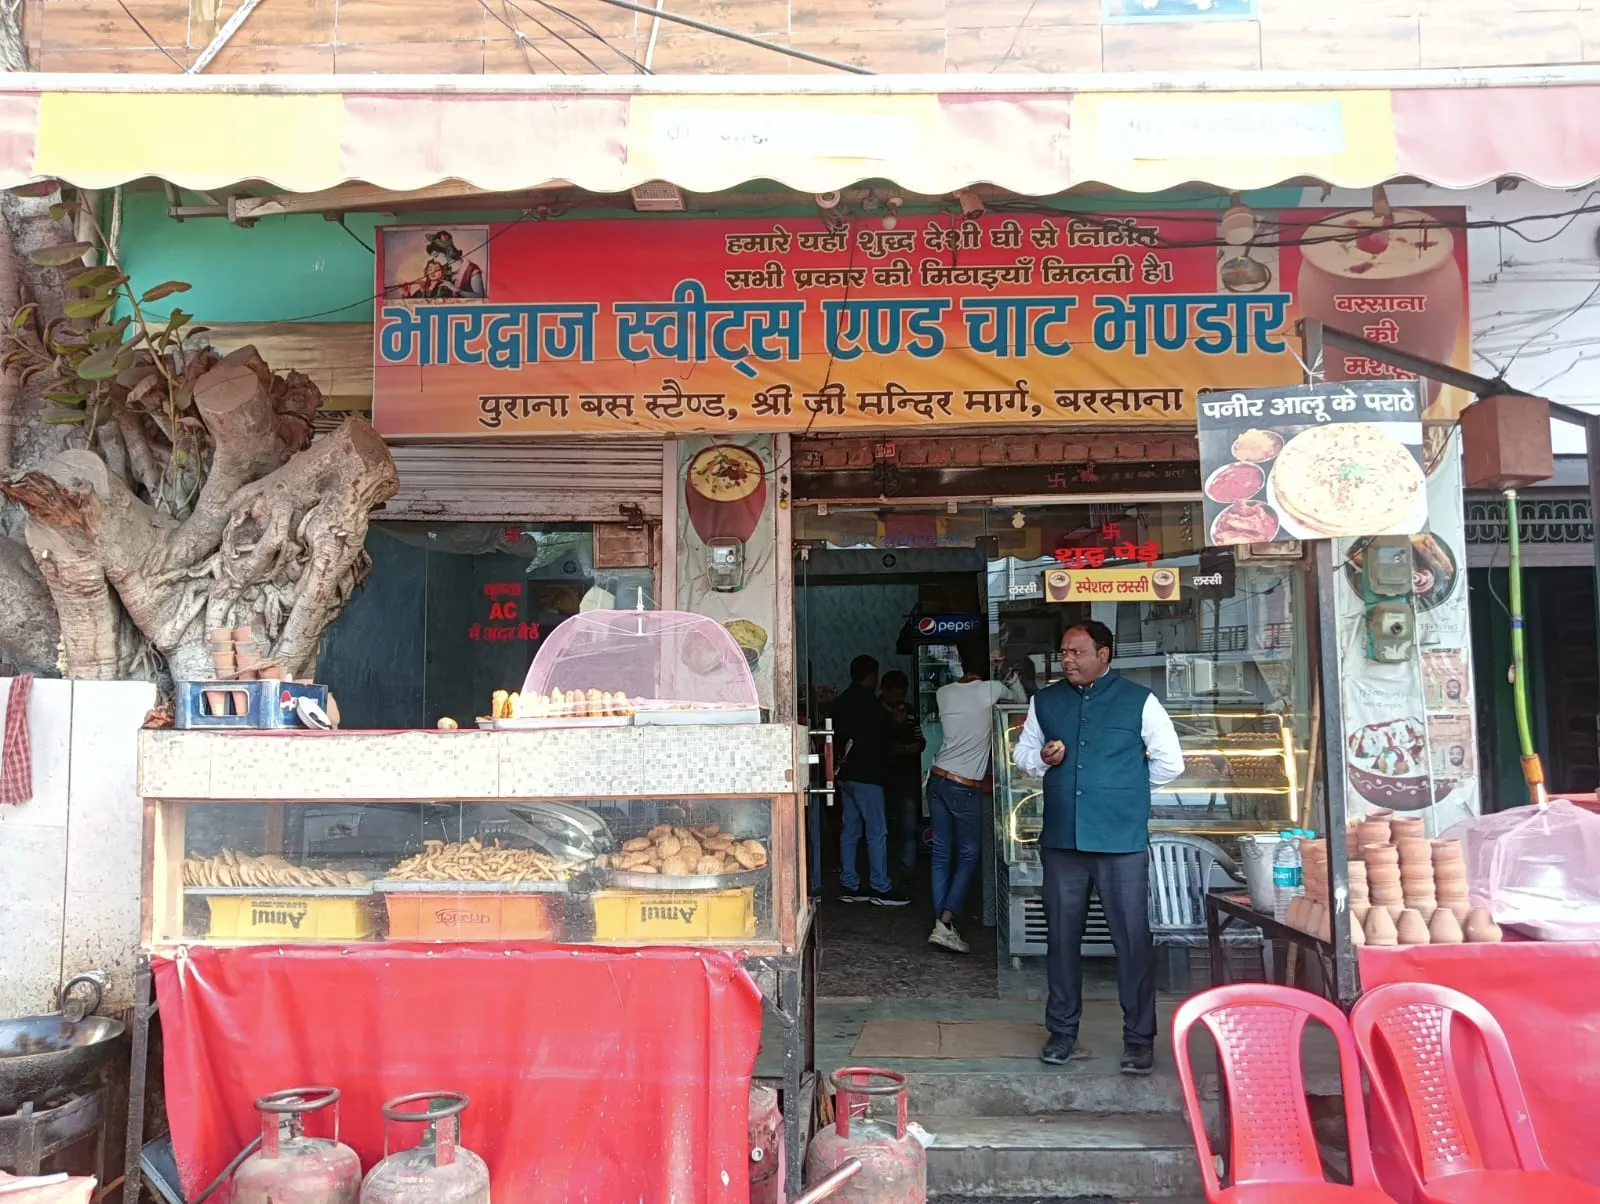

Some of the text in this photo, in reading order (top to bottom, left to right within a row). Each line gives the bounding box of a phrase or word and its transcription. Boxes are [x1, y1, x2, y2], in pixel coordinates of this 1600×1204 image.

[725, 224, 792, 253] हमारे
[798, 224, 850, 252] यहाँ
[857, 231, 916, 259] शुद्ध
[924, 220, 983, 252] देशी
[989, 219, 1022, 250] घी
[1030, 220, 1059, 248] से
[725, 260, 786, 290] सभी
[793, 267, 867, 291] प्रकार
[872, 259, 911, 287] की
[920, 257, 1034, 291] मिठाइयाँ
[1040, 254, 1135, 284] मिलती
[1334, 295, 1427, 313] बरसाना
[379, 279, 1290, 378] भारद्वाज स्वीट्स एण्ड चाट भण्डार
[1363, 318, 1399, 343] की
[478, 379, 1184, 428] पुराना बस स्टैण्ड, श्री जी मन्दिर मार्ग, बरसाना
[1201, 389, 1416, 422] पनीर आलू के पराठे
[1076, 576, 1149, 594] स्पेशल लस्सी
[1192, 572, 1222, 586] लस्सी
[489, 601, 518, 619] AC
[938, 619, 974, 633] pepsi
[251, 908, 307, 929] Amul
[641, 905, 698, 924] Amul
